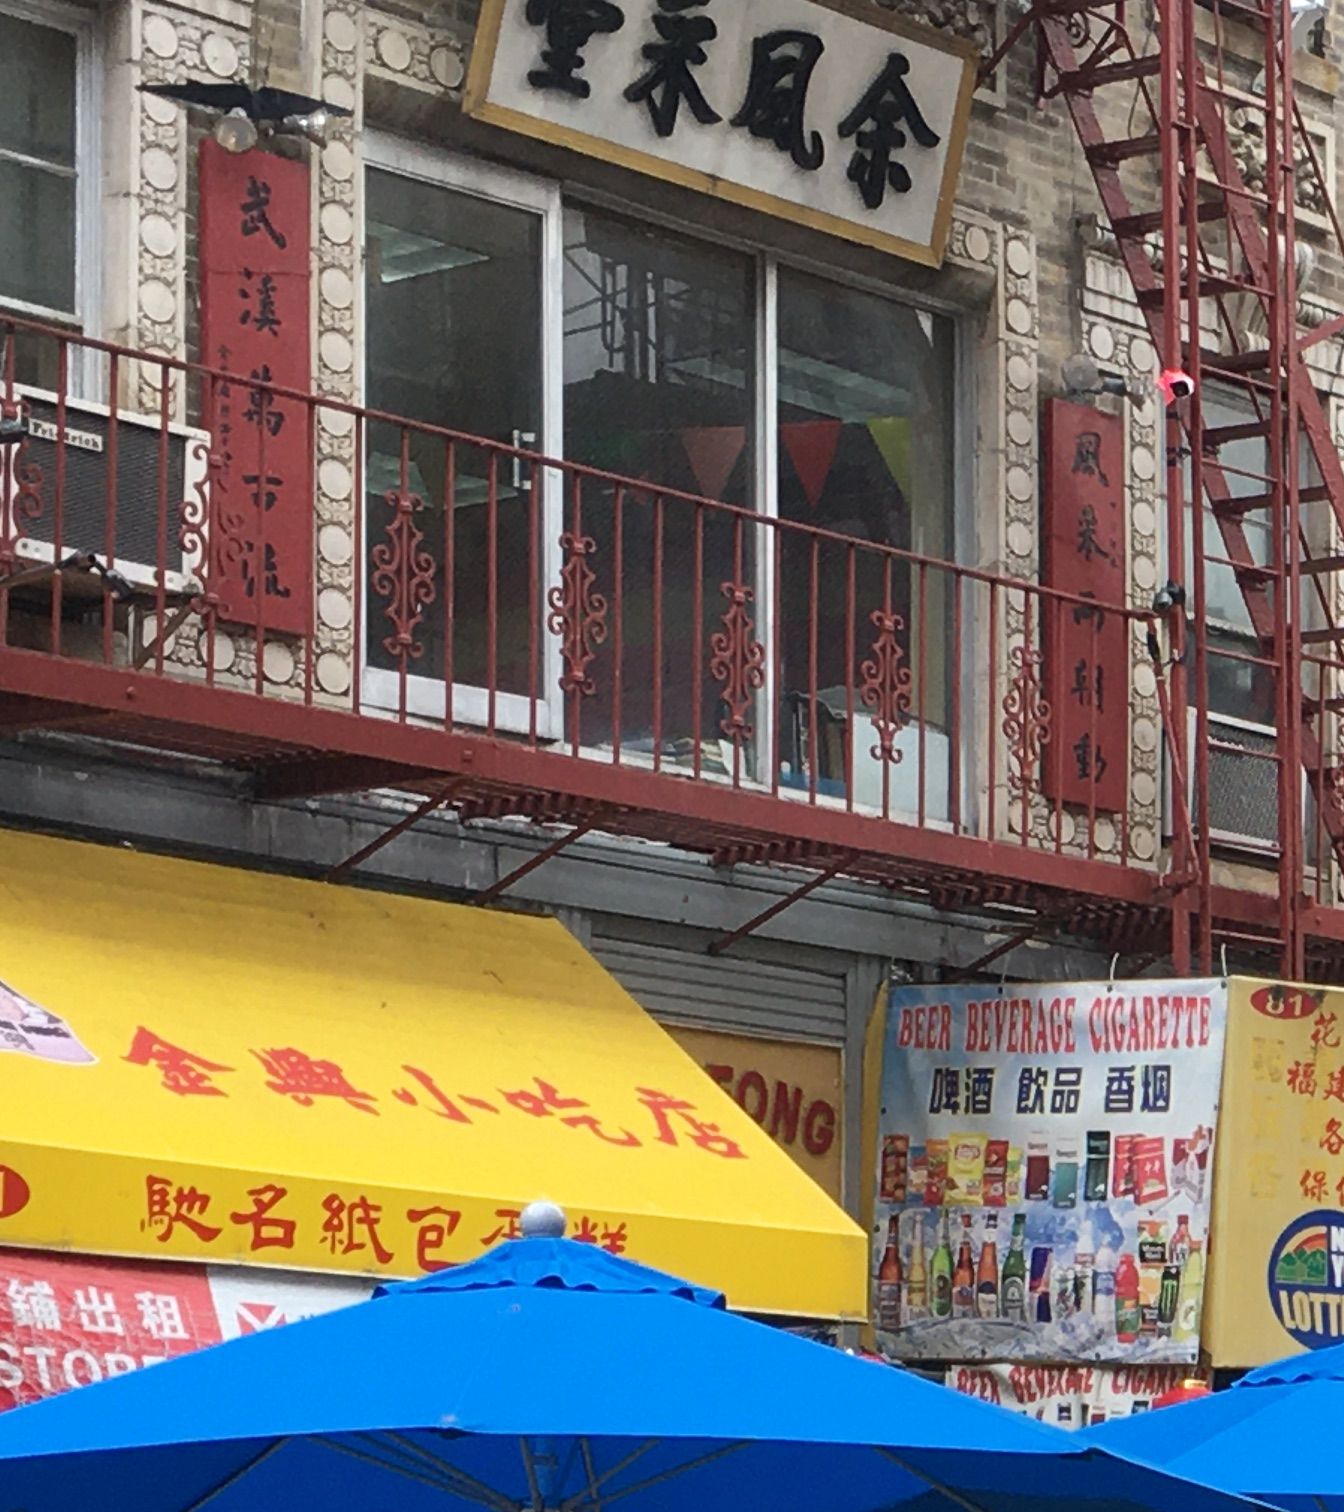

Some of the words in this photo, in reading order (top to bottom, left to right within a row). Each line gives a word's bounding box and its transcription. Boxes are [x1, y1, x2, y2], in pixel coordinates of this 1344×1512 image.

[898, 1003, 952, 1050] BEER
[966, 997, 1077, 1053] BEVERAGE
[1089, 995, 1212, 1052] CIGARETTE
[929, 1066, 995, 1115] 啤酒
[1016, 1066, 1083, 1115] 飲品
